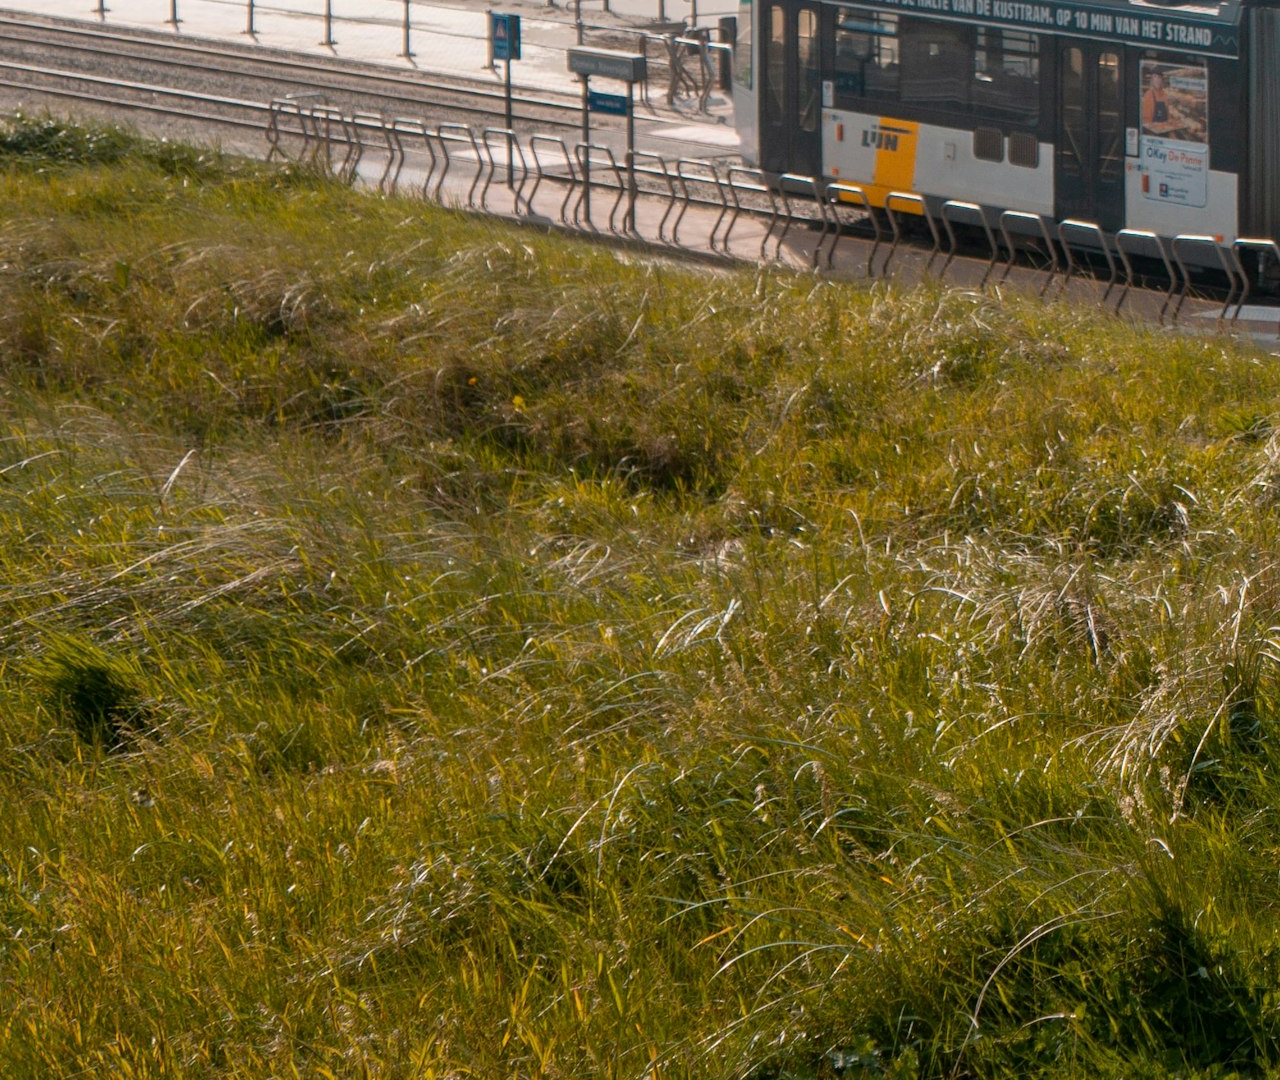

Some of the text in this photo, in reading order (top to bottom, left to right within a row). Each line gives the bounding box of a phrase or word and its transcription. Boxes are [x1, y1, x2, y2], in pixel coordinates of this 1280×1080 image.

[1056, 8, 1071, 27] OP
[1075, 11, 1088, 30] 10
[1090, 13, 1113, 33] MIN
[1115, 16, 1139, 36] VAN
[1142, 20, 1164, 40] HET
[1166, 23, 1212, 47] STRAND
